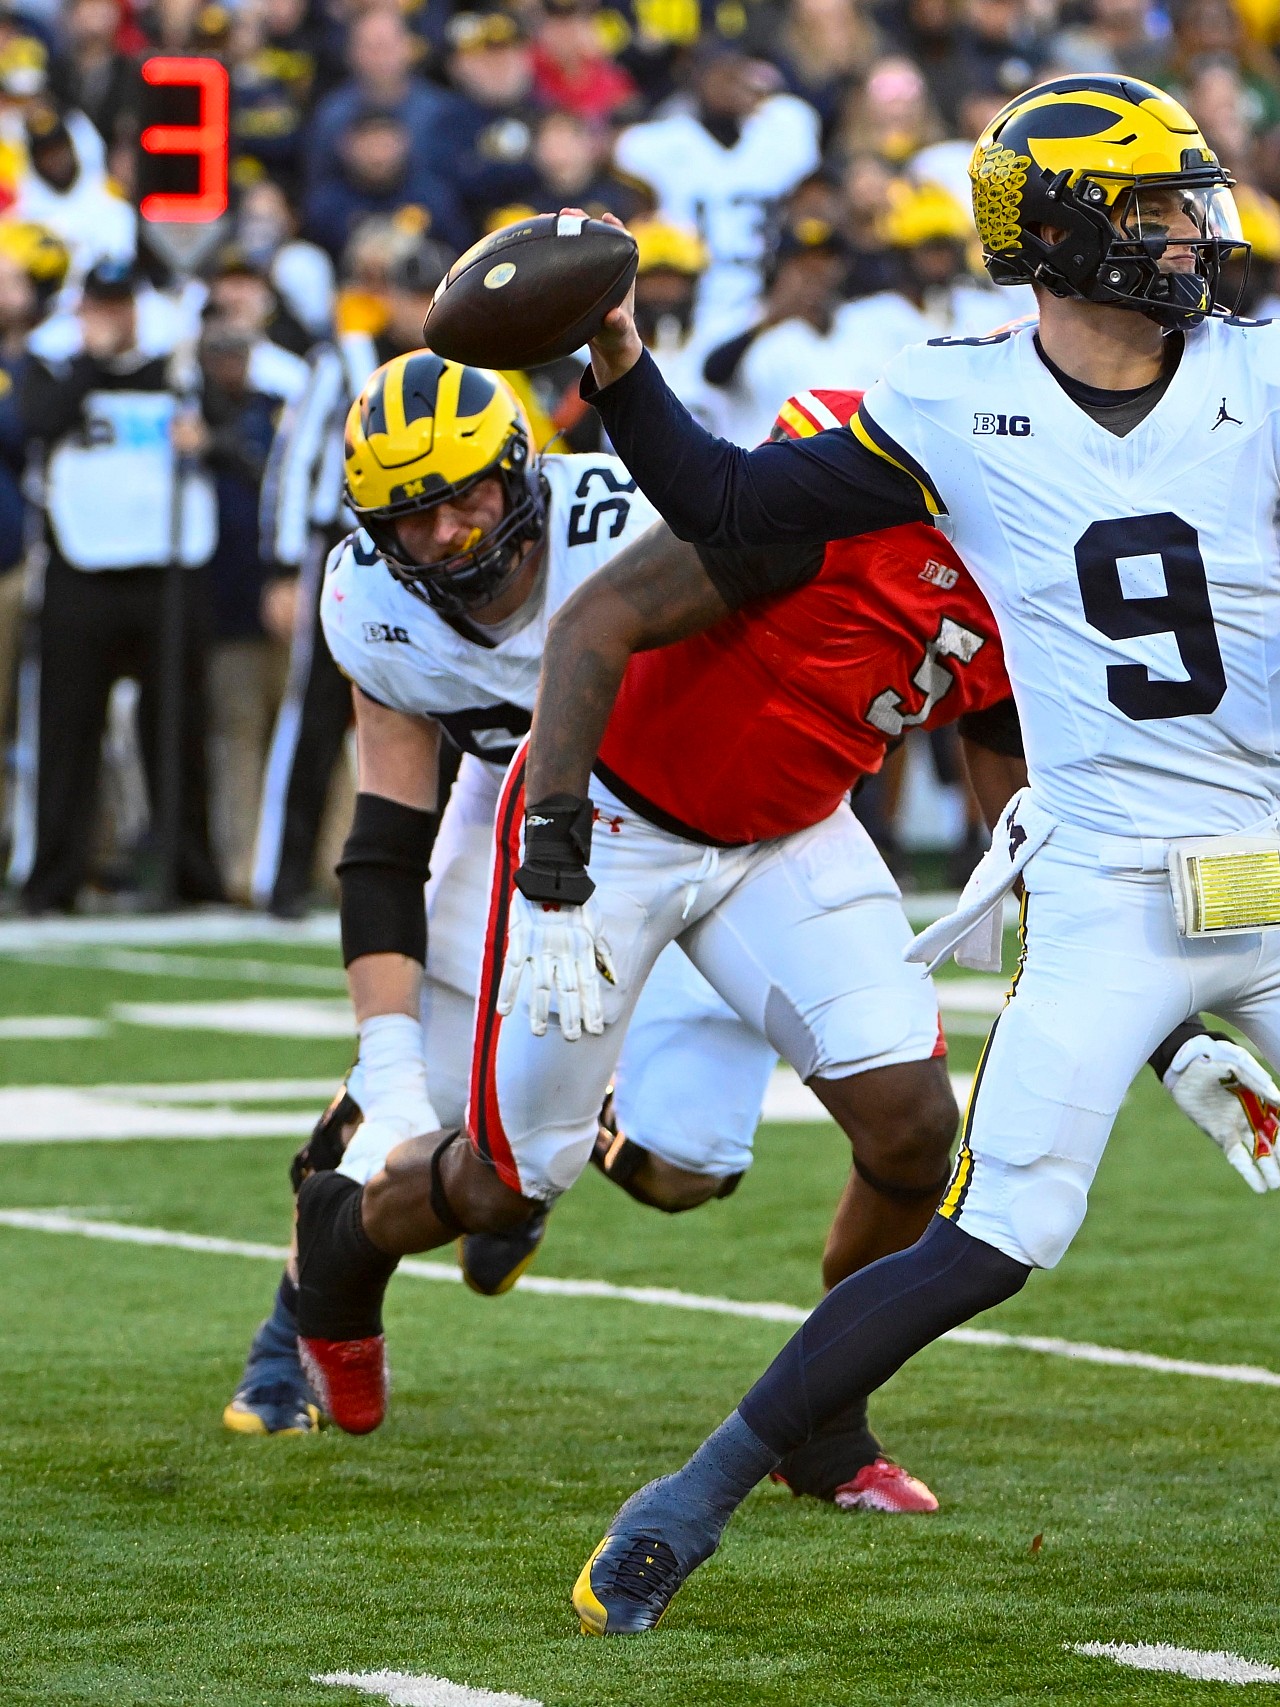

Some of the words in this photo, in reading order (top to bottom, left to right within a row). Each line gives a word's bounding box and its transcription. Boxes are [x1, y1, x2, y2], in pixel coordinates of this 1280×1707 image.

[140, 56, 229, 223] 3
[567, 467, 638, 548] 52
[865, 615, 988, 736] 5
[1073, 511, 1228, 722] 9
